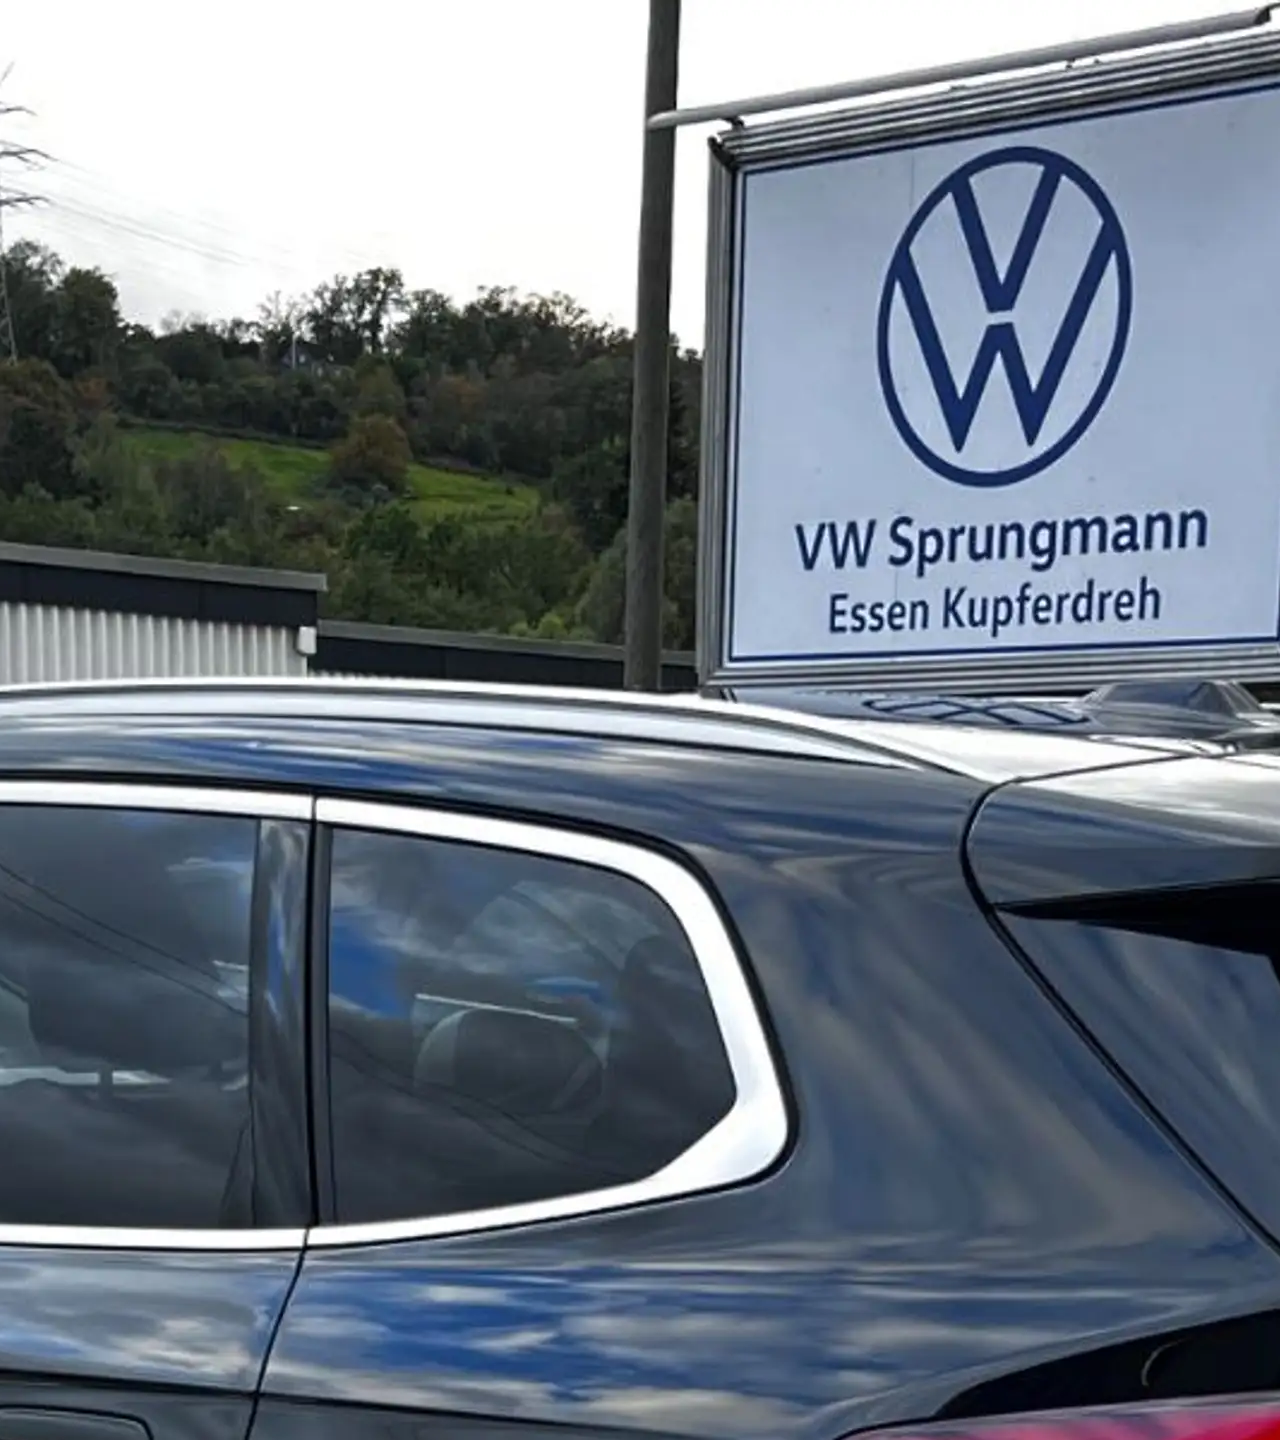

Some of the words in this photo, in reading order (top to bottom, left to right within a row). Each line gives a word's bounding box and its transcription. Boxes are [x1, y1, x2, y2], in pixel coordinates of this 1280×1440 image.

[795, 519, 877, 571] VW
[887, 507, 1209, 577] Sprungmann
[828, 592, 930, 635] Essen
[942, 575, 1162, 638] Kupferdreh
